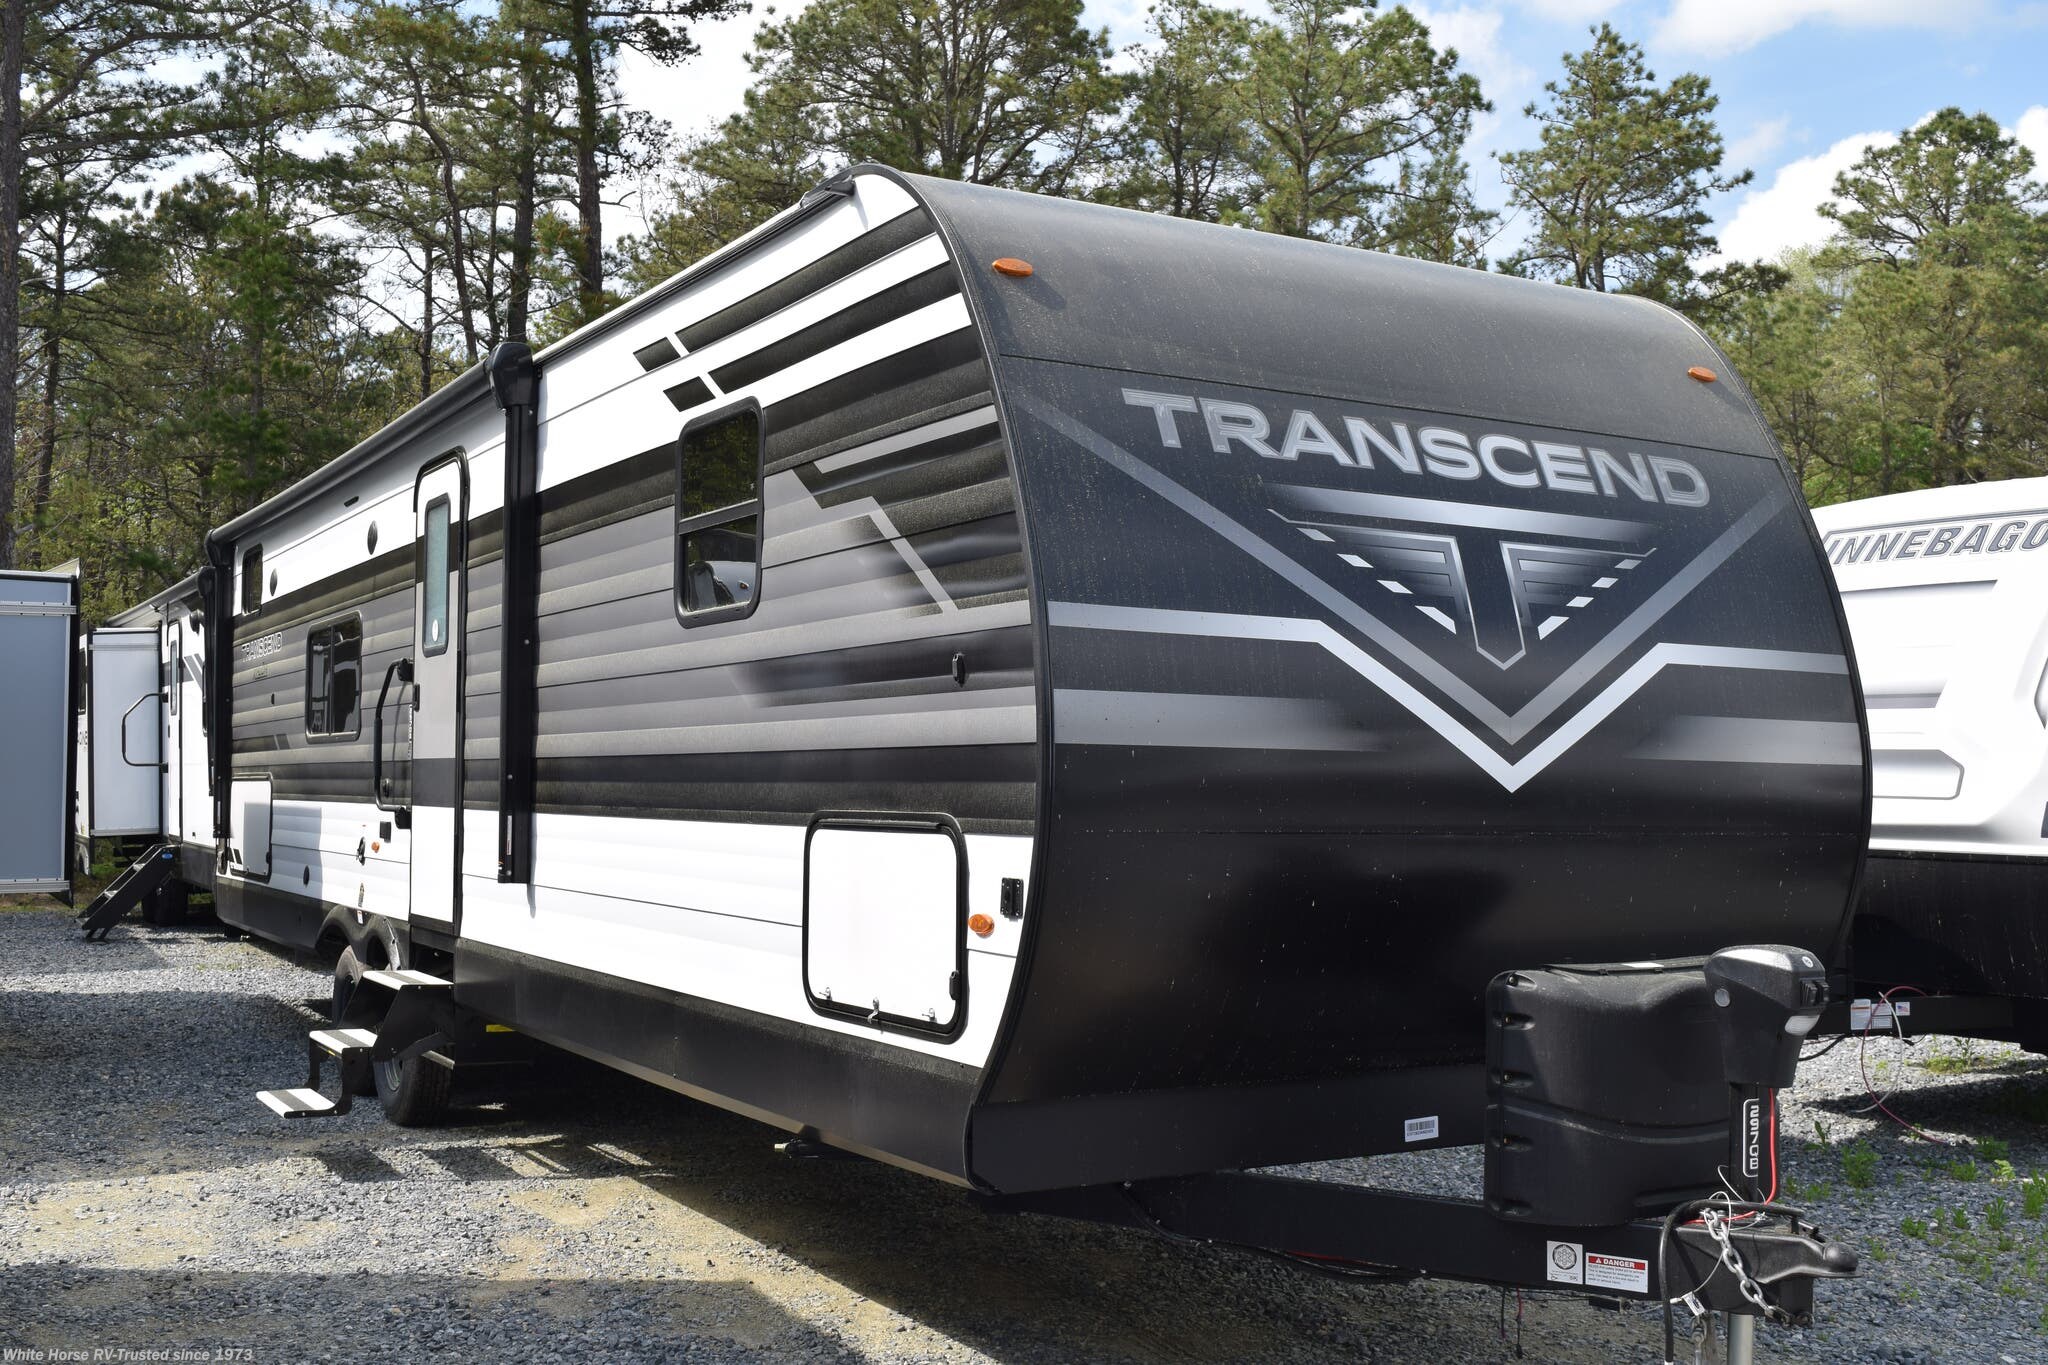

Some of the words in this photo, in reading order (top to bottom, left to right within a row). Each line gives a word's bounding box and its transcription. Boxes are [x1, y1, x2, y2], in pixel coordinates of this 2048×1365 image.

[1121, 388, 1710, 507] TRANSCEND
[1749, 1105, 1760, 1170] 297QB
[1603, 1258, 1635, 1269] DANGER
